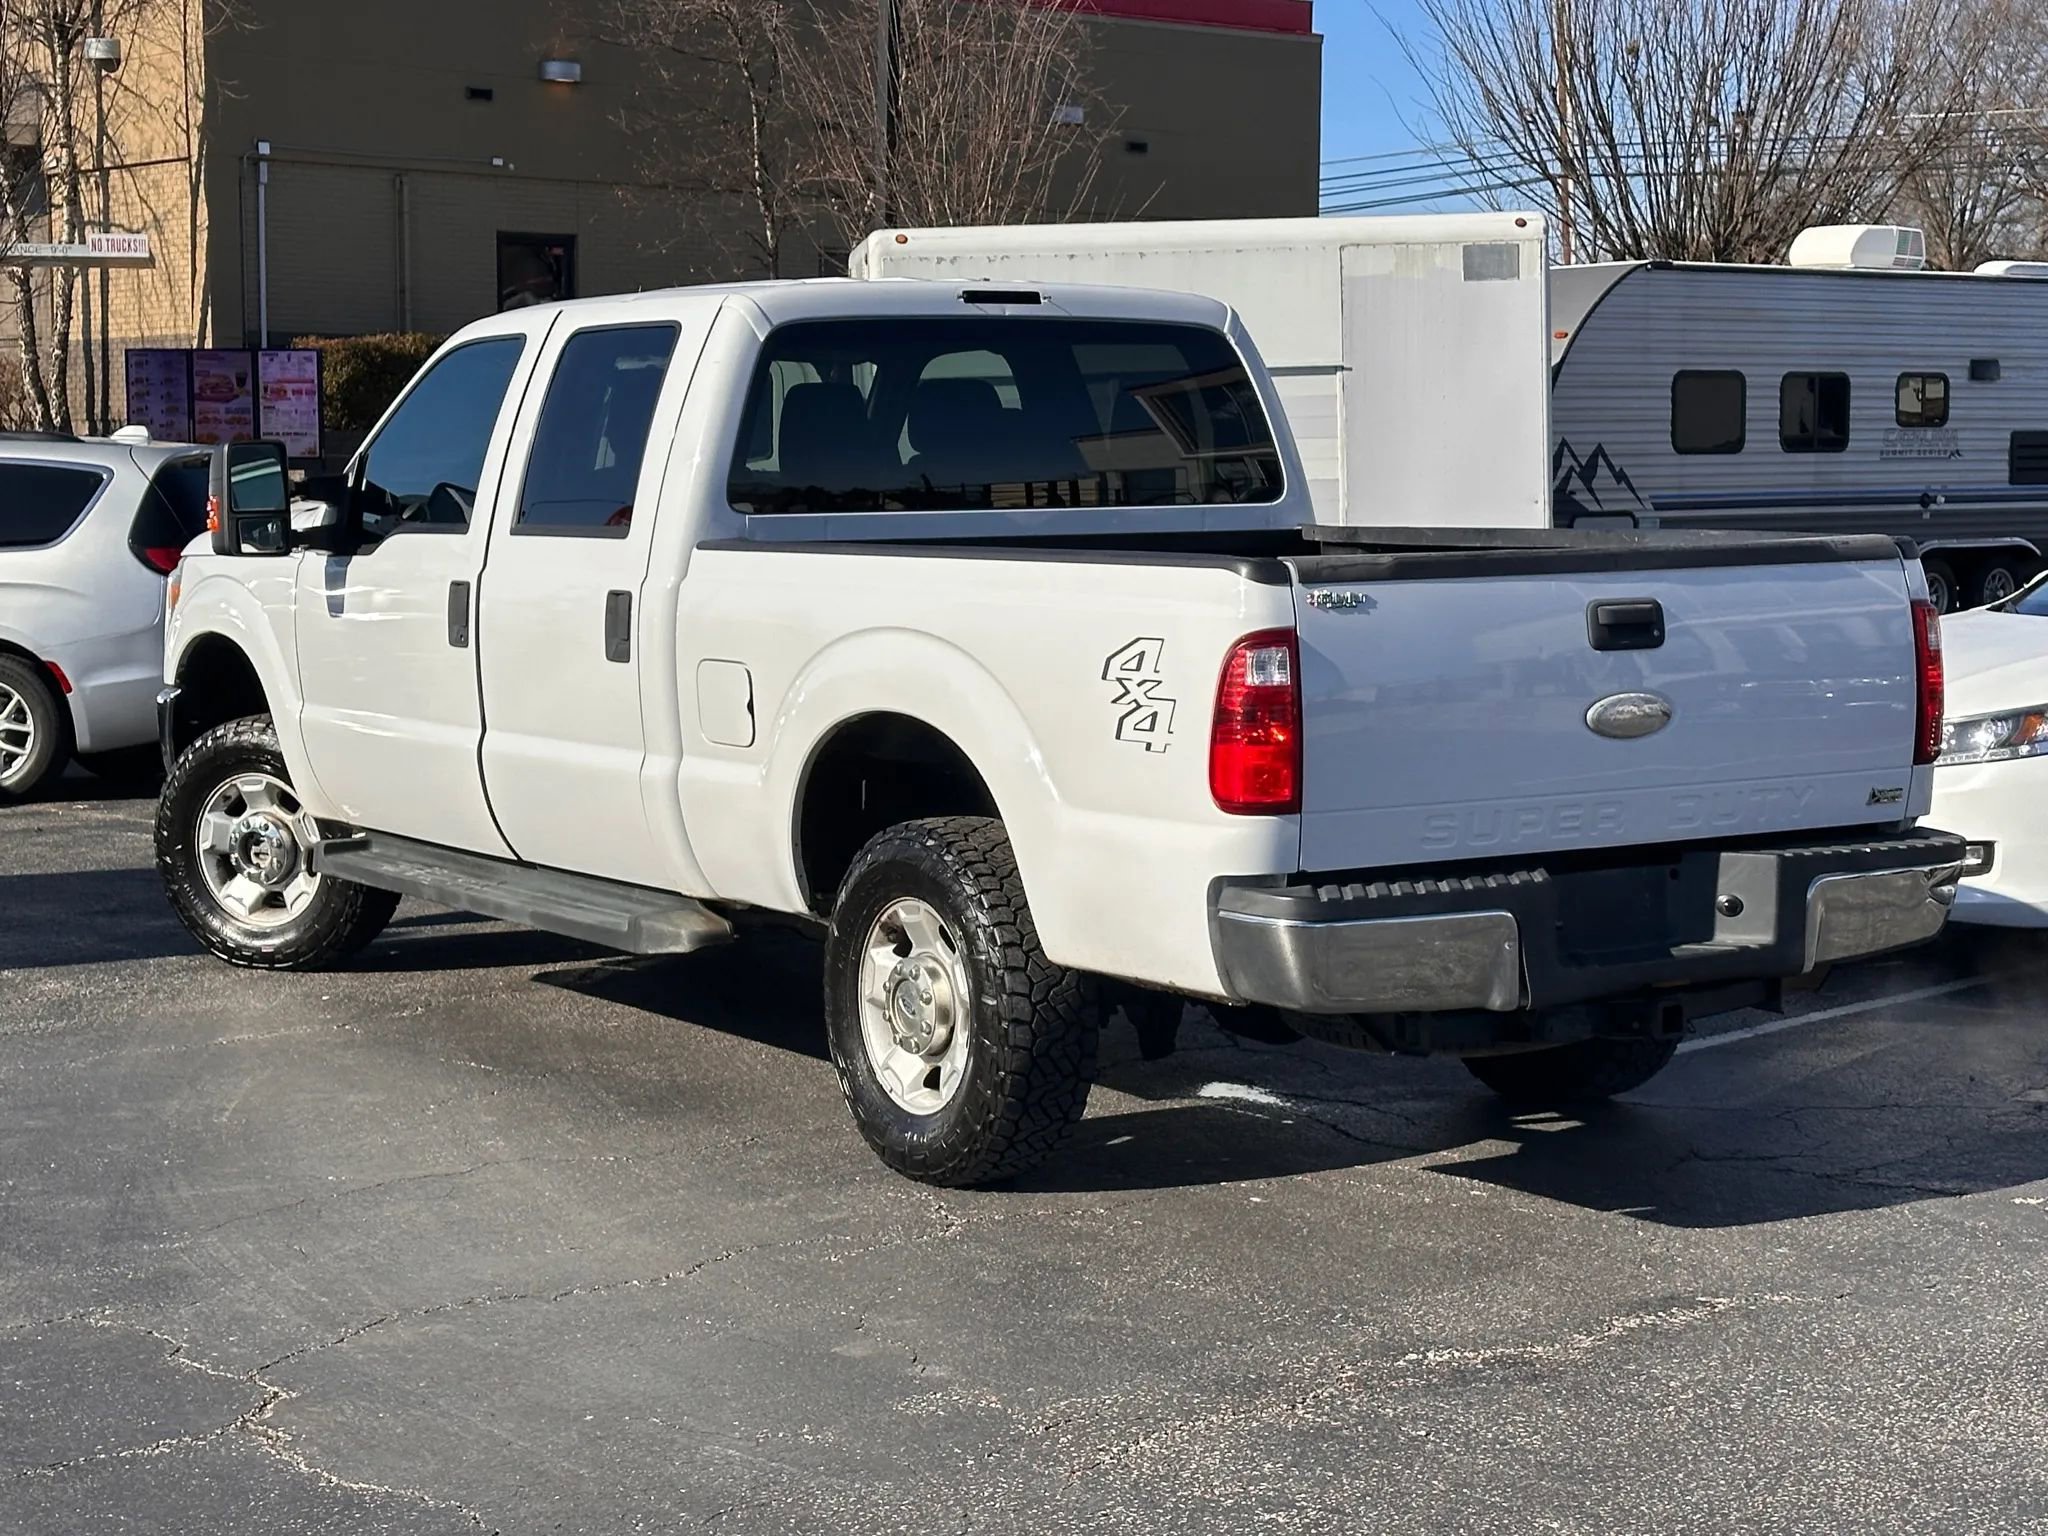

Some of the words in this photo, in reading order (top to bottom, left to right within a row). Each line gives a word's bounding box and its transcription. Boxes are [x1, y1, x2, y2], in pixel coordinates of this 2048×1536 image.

[91, 238, 103, 252] NO
[1420, 800, 1626, 850] SUPER
[1668, 785, 1817, 830] DUTY
